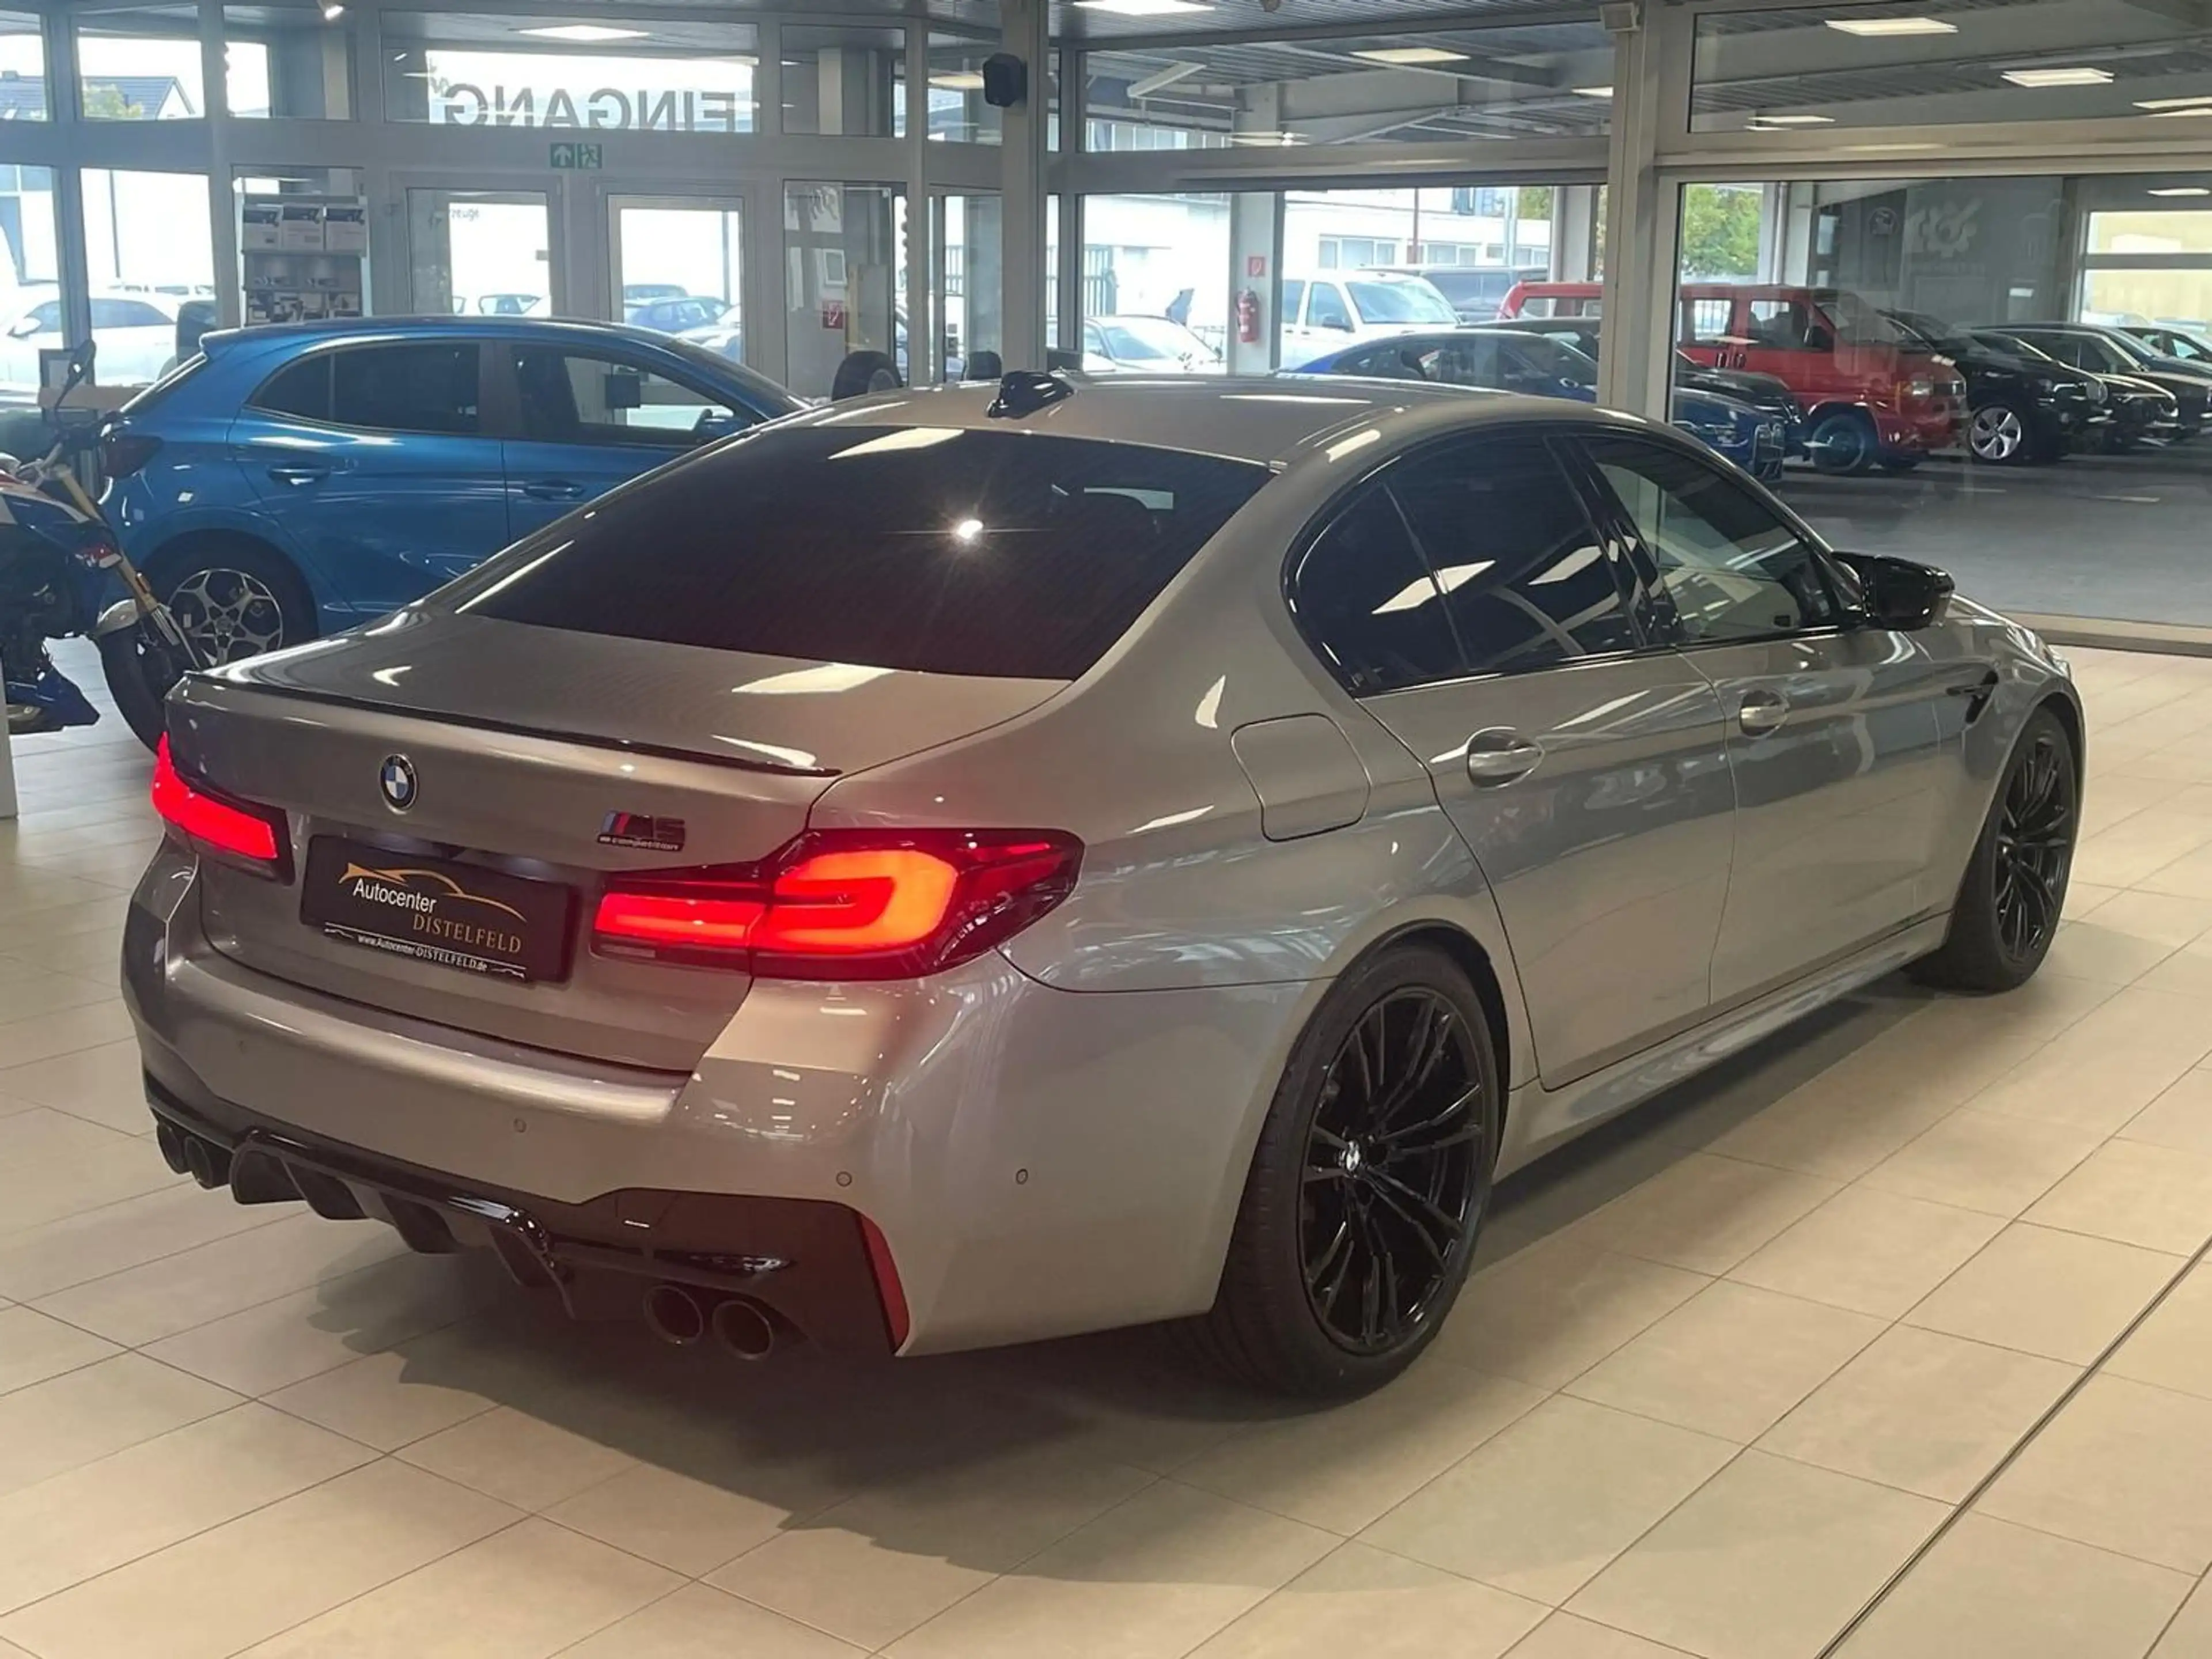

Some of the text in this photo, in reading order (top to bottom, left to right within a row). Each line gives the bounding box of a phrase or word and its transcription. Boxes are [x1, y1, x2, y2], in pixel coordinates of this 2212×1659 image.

[604, 810, 685, 843] M5
[353, 878, 437, 914] Autocenter
[413, 914, 522, 953] DISTELFELD
